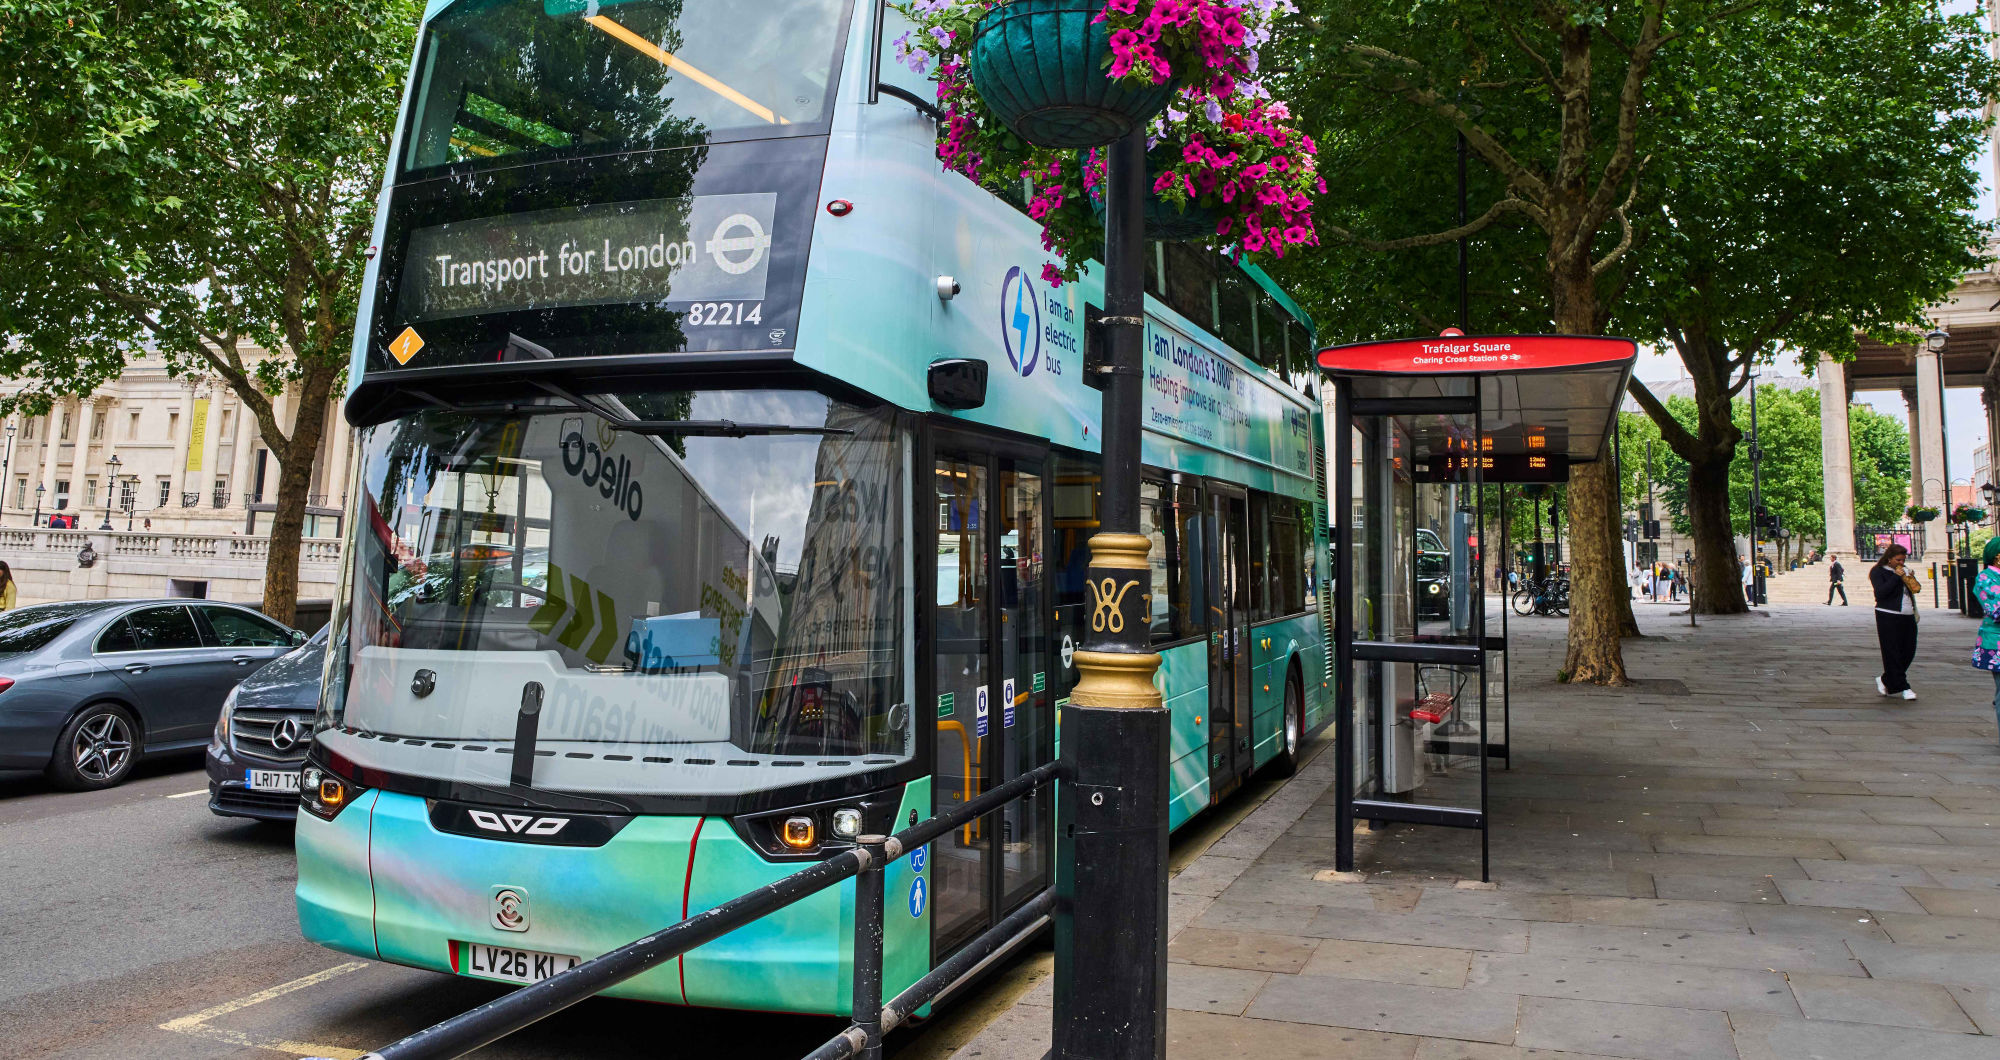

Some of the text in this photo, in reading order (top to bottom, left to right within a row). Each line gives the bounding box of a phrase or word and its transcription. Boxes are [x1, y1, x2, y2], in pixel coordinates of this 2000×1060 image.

[436, 233, 697, 292] Transport for London
[688, 302, 762, 326] 82214
[1043, 289, 1074, 325] I am an
[1045, 322, 1077, 354] electric
[1147, 321, 1152, 352] I
[1154, 333, 1170, 361] am
[1171, 335, 1210, 380] London's
[1422, 342, 1511, 354] Trafalgar Square
[1046, 349, 1062, 376] bus
[1413, 354, 1498, 365] Charing Cross Station
[1149, 365, 1179, 404] Helping
[1180, 379, 1207, 410] improve
[1208, 393, 1216, 414] air
[255, 772, 300, 789] LR17 TX
[472, 945, 528, 978] LV26
